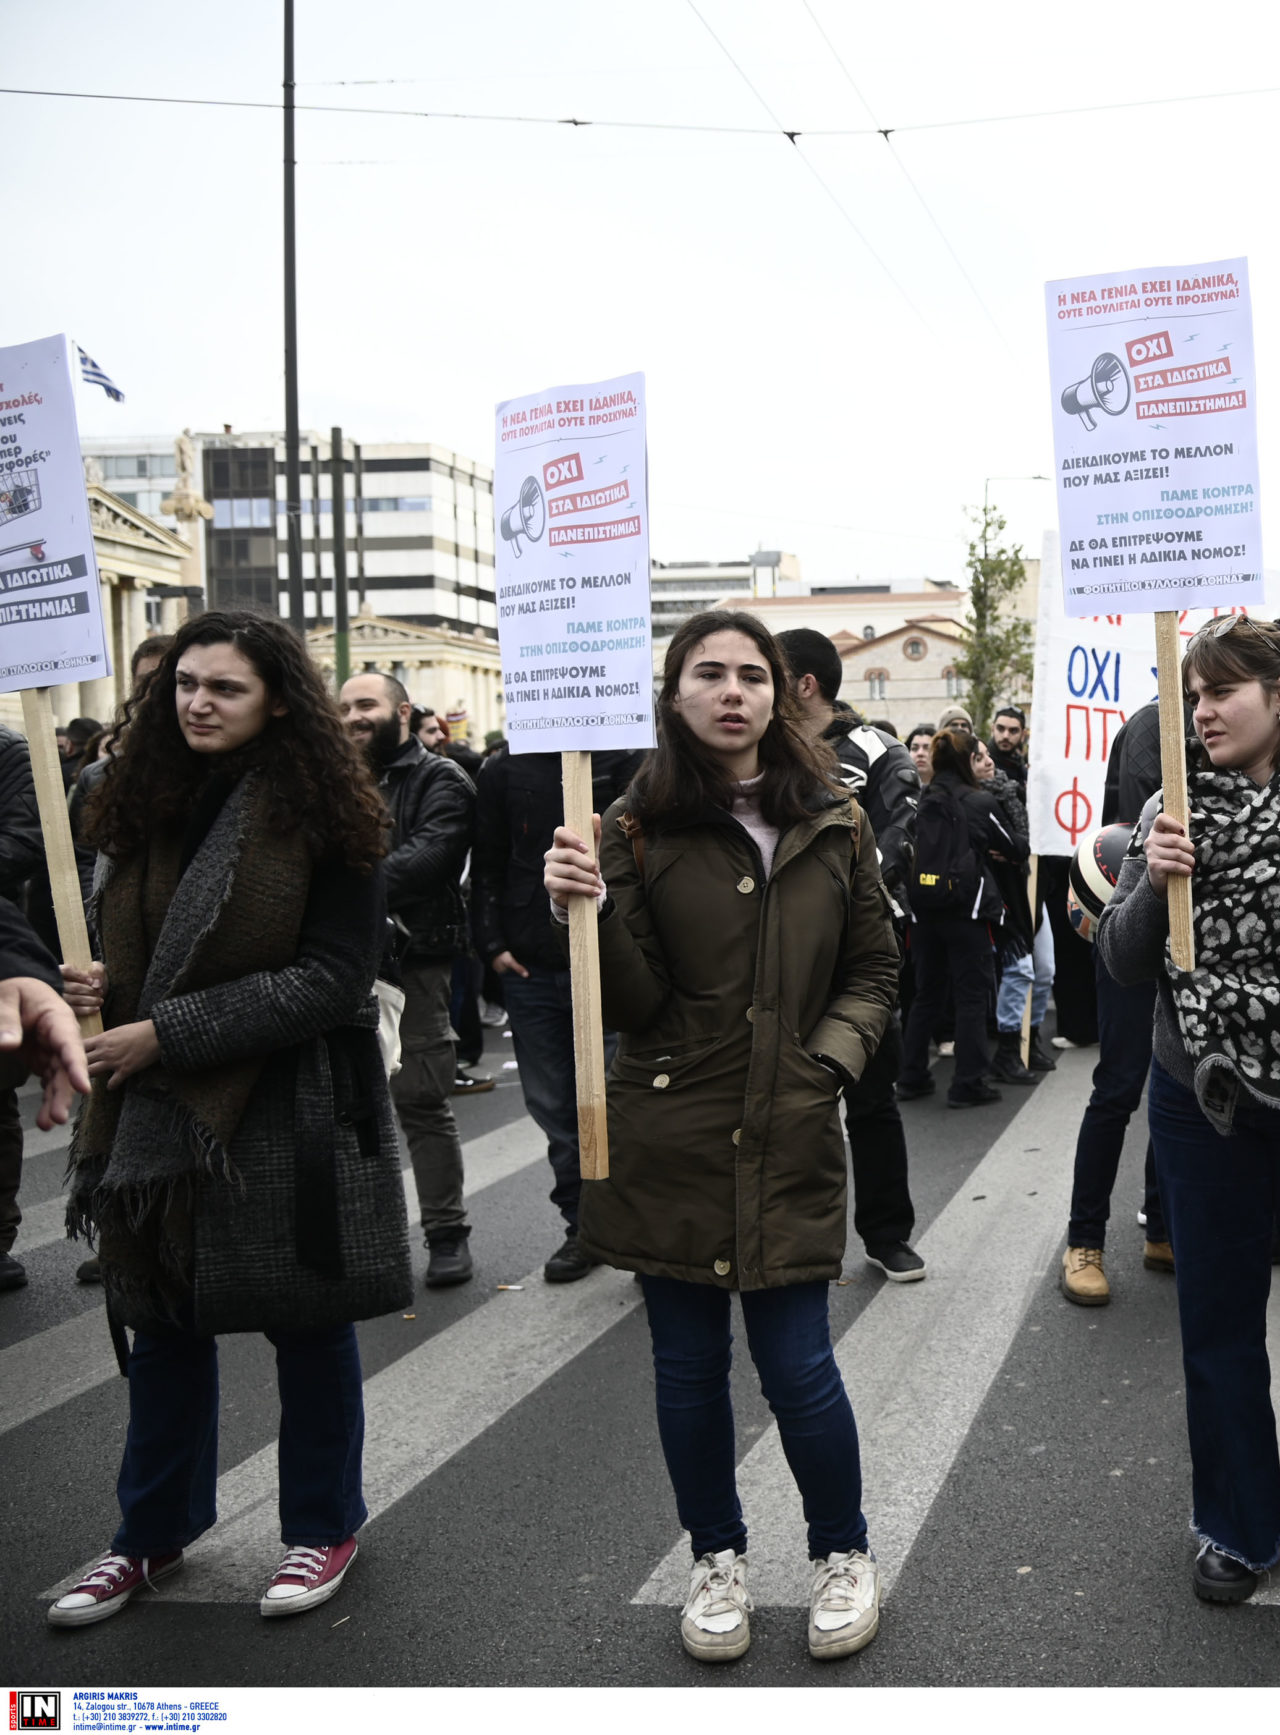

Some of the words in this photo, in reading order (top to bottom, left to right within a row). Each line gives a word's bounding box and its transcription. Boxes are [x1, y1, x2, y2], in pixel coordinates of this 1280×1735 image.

[1058, 295, 1066, 306] Η
[1071, 291, 1097, 304] ΝΕΑ
[1100, 284, 1138, 300] ΓΕΝΙΑ
[1142, 280, 1171, 294] ΕΧΕΙ
[1176, 273, 1238, 290] ΙΔΑΝΙΚΑ,
[1058, 308, 1083, 319] ΟΥΤΕ
[1086, 300, 1140, 316] ΠΟΥΛΙΕΤΑΙ
[1144, 296, 1172, 308] ΟΥΤΕ
[1176, 288, 1239, 306] ΠΡΟΣΚΥΝΑ!
[1131, 337, 1168, 361] ΟΧΙ
[1138, 374, 1163, 390] ΣΤΑ
[1168, 361, 1228, 384] ΙΔΙΩΤΙΚΑ
[502, 418, 508, 428] Η
[510, 413, 527, 426] ΝΕΑ
[530, 403, 553, 421] ΓΕΝΙΑ
[556, 400, 584, 413] ΕΧΕΙ
[589, 390, 636, 412] ΙΔΑΝΙΚΑ,
[1139, 394, 1242, 417] ΠΑΝΕΠΙΣΤΗΜΙΑ!
[502, 430, 517, 442] ΟΥΤΕ
[519, 418, 554, 438] ΠΟΥΛΙΕΤΑΙ
[558, 416, 584, 428] ΟΥΤΕ
[588, 406, 637, 426] ΠΡΟΣΚΥΝΑ!
[1062, 450, 1147, 470] ΔΙΕΚΔΙΚΟΥΜΕ
[1150, 448, 1170, 460] ΤΟ
[1174, 443, 1234, 459] ΜΕΛΛΟΝ
[546, 460, 578, 484] ΟΧΙ
[1063, 475, 1089, 488] ΠΟΥ
[1094, 472, 1120, 485] ΜΑΣ
[1124, 466, 1170, 482] ΑΞΙΖΕΙ!
[551, 498, 574, 514] ΣΤΑ
[576, 484, 627, 508] ΙΔΙΩΤΙΚΑ
[1160, 489, 1198, 502] ΠΑΜΕ
[1202, 484, 1254, 498] ΚΟΝΤΡΑ
[1096, 512, 1128, 526] ΣΤΗΝ
[1132, 502, 1254, 522] ΟΠΙΣΘΟΔΡΟΜΗΣΗ!
[552, 520, 638, 542] ΠΑΝΕΠΙΣΤΗΜΙΑ!
[1069, 540, 1084, 552] ΔΕ
[1088, 538, 1108, 550] ΘΑ
[1112, 530, 1203, 548] ΕΠΙΤΡΕΨΟΥΜΕ
[1071, 558, 1090, 570] ΝΑ
[1093, 554, 1124, 568] ΓΙΝΕΙ
[1128, 553, 1136, 565] Η
[1140, 549, 1188, 564] ΑΔΙΚΙΑ
[1191, 544, 1246, 560] ΝΟΜΟΣ!
[6, 563, 72, 588] ΙΔΙΩΤΙΚΑ
[500, 578, 556, 599] ΔΙΕΚΔΙΚΟΥΜΕ
[560, 577, 576, 589] ΤΟ
[581, 572, 632, 588] ΜΕΛΛΟΝ
[1084, 582, 1144, 594] ΦΟΙΤΗΤΙΚΟΙ
[1144, 577, 1199, 590] ΣΥΛΛΟΓΟΙ
[1200, 574, 1244, 586] ΑΘΗΝΑΣ
[500, 604, 516, 618] ΠΟΥ
[518, 602, 536, 614] ΜΑΣ
[539, 596, 576, 612] ΑΞΙΖΕΙ!
[566, 621, 604, 634] ΠΑΜΕ
[606, 616, 646, 632] ΚΟΝΤΡΑ
[520, 644, 544, 658] ΣΤΗΝ
[546, 636, 646, 654] ΟΠΙΣΘΟΔΡΟΜΗΣΗ!
[505, 672, 512, 684] ΔΕ
[514, 671, 528, 683] ΘΑ
[530, 666, 606, 682] ΕΠΙΤΡΕΨΟΥΜΕ
[1067, 644, 1121, 702] ΟΧΙ
[506, 692, 515, 704] ΝΑ
[516, 688, 540, 702] ΓΙΝΕΙ
[543, 688, 549, 700] Η
[551, 686, 590, 700] ΑΔΙΚΙΑ
[596, 682, 639, 698] ΝΟΜΟΣ!
